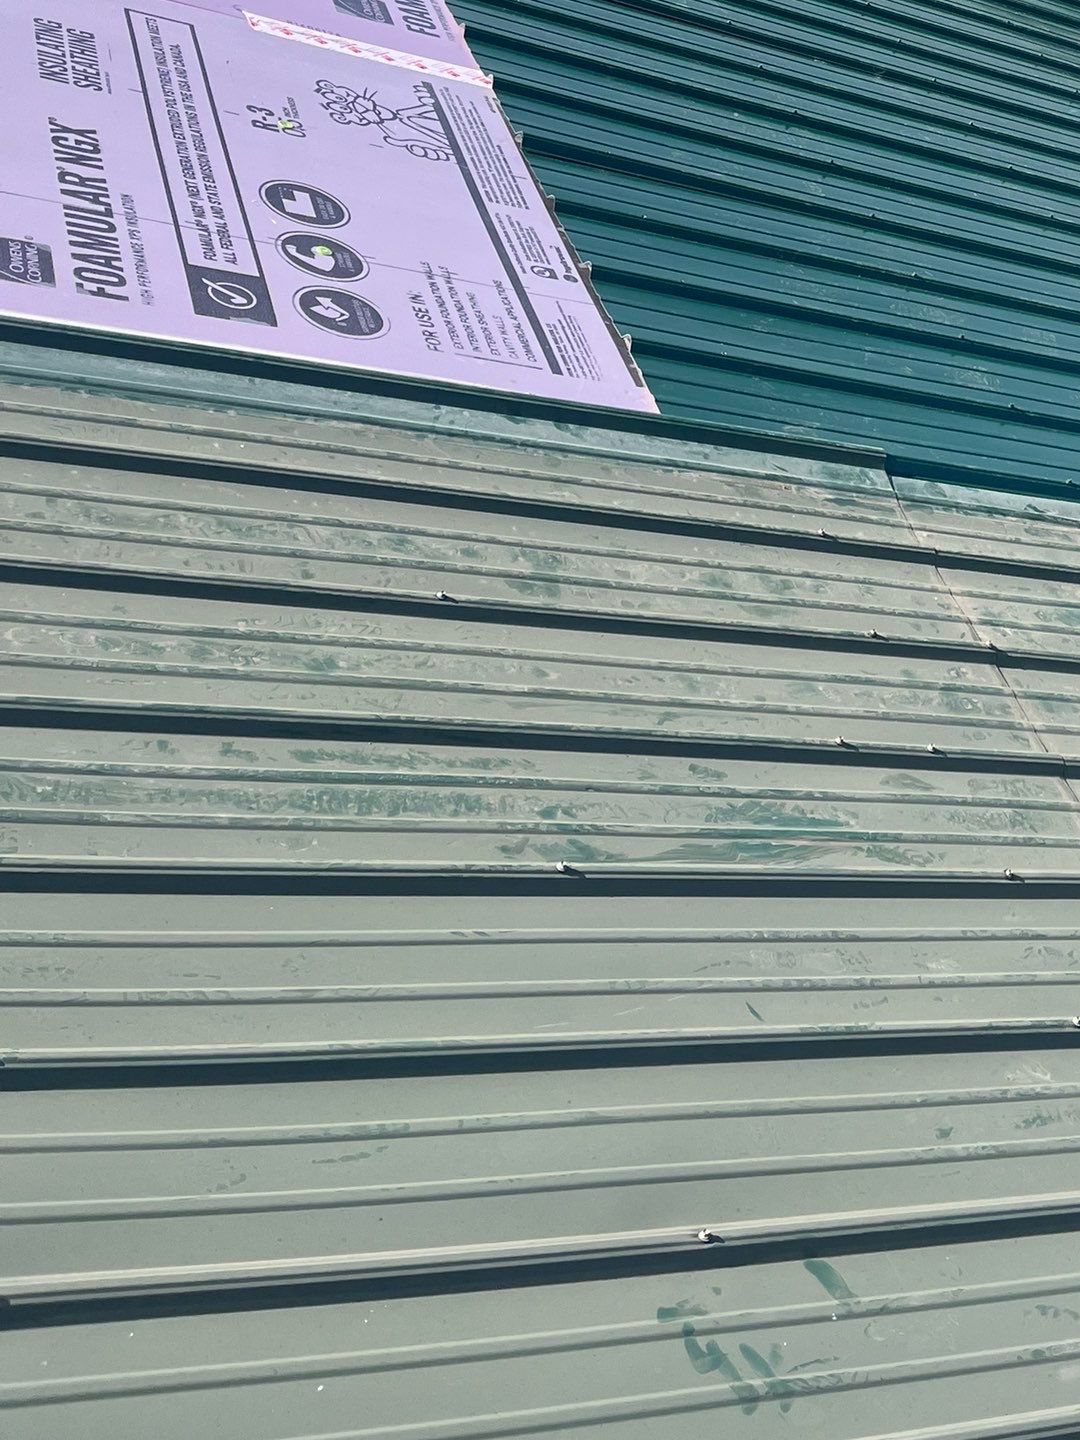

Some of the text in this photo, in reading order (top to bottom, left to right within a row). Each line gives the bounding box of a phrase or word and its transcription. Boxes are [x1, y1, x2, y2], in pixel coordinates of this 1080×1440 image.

[33, 17, 69, 84] INSULATING
[66, 27, 103, 91] SHEATHING
[246, 104, 280, 133] R-3
[410, 305, 433, 329] USE
[419, 327, 442, 352] FOR
